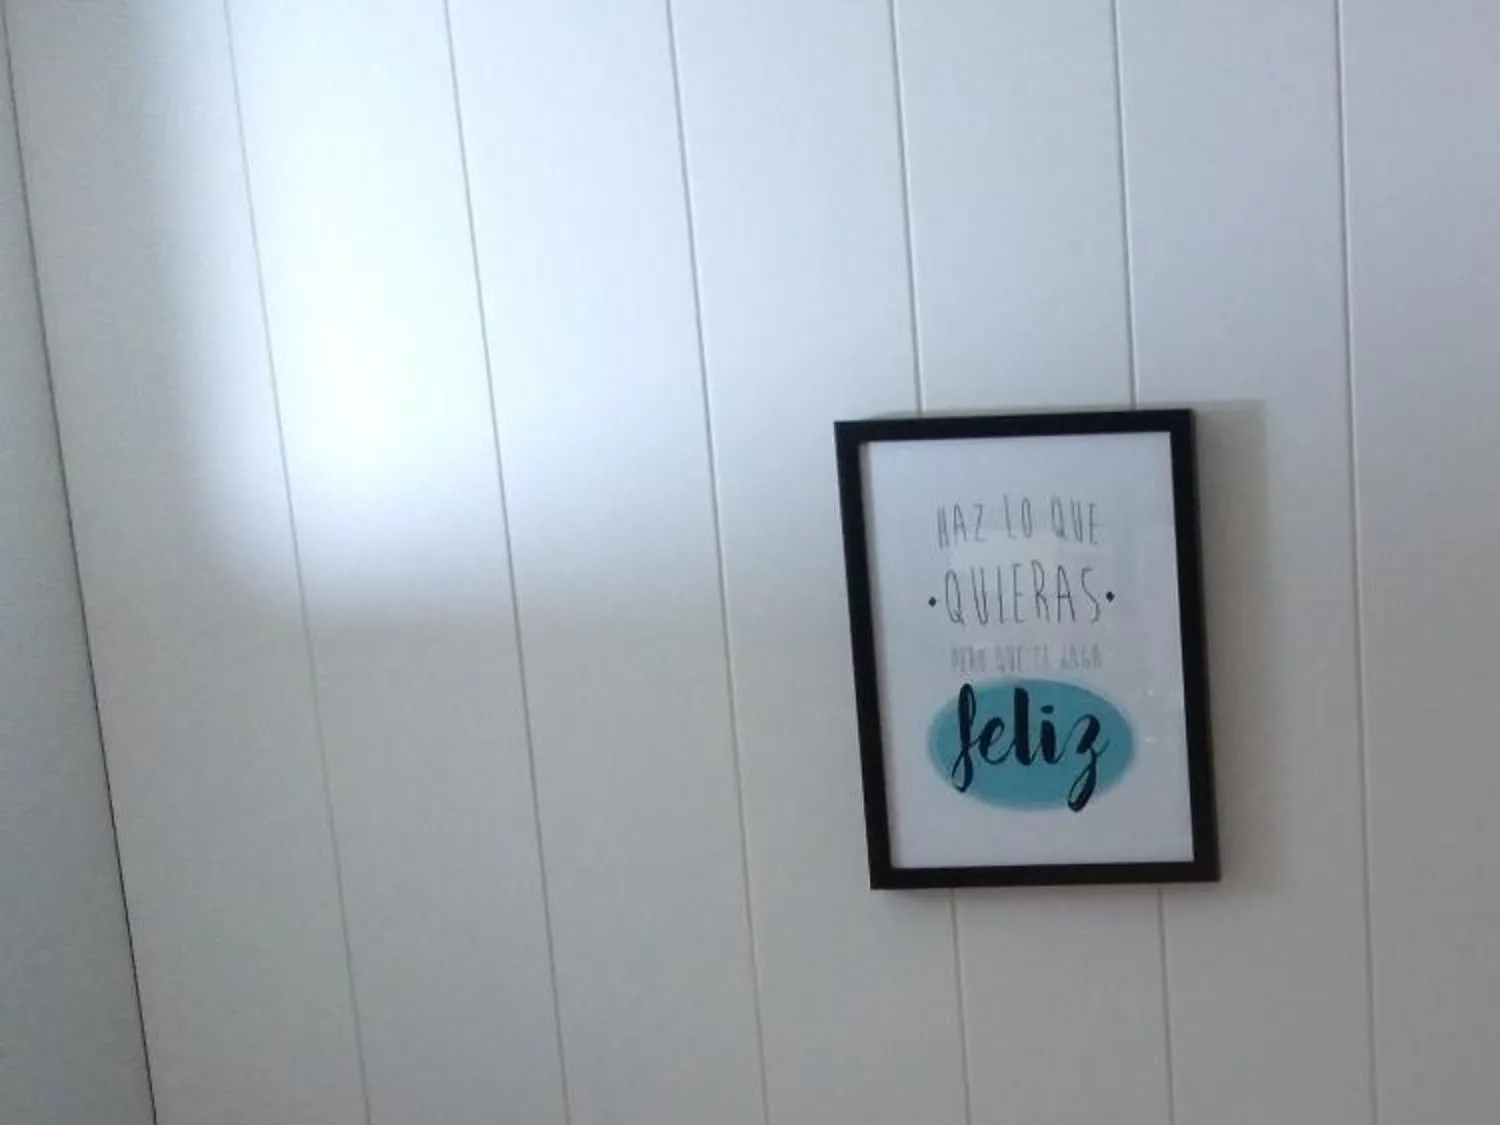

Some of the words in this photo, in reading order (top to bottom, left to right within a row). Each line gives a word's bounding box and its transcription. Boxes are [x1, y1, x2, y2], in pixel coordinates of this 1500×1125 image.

[937, 503, 988, 549] HAZ
[1003, 494, 1034, 539] LO
[1050, 496, 1100, 545] QUE
[944, 558, 1101, 625] QUIERAS
[951, 683, 1109, 812] feliz
